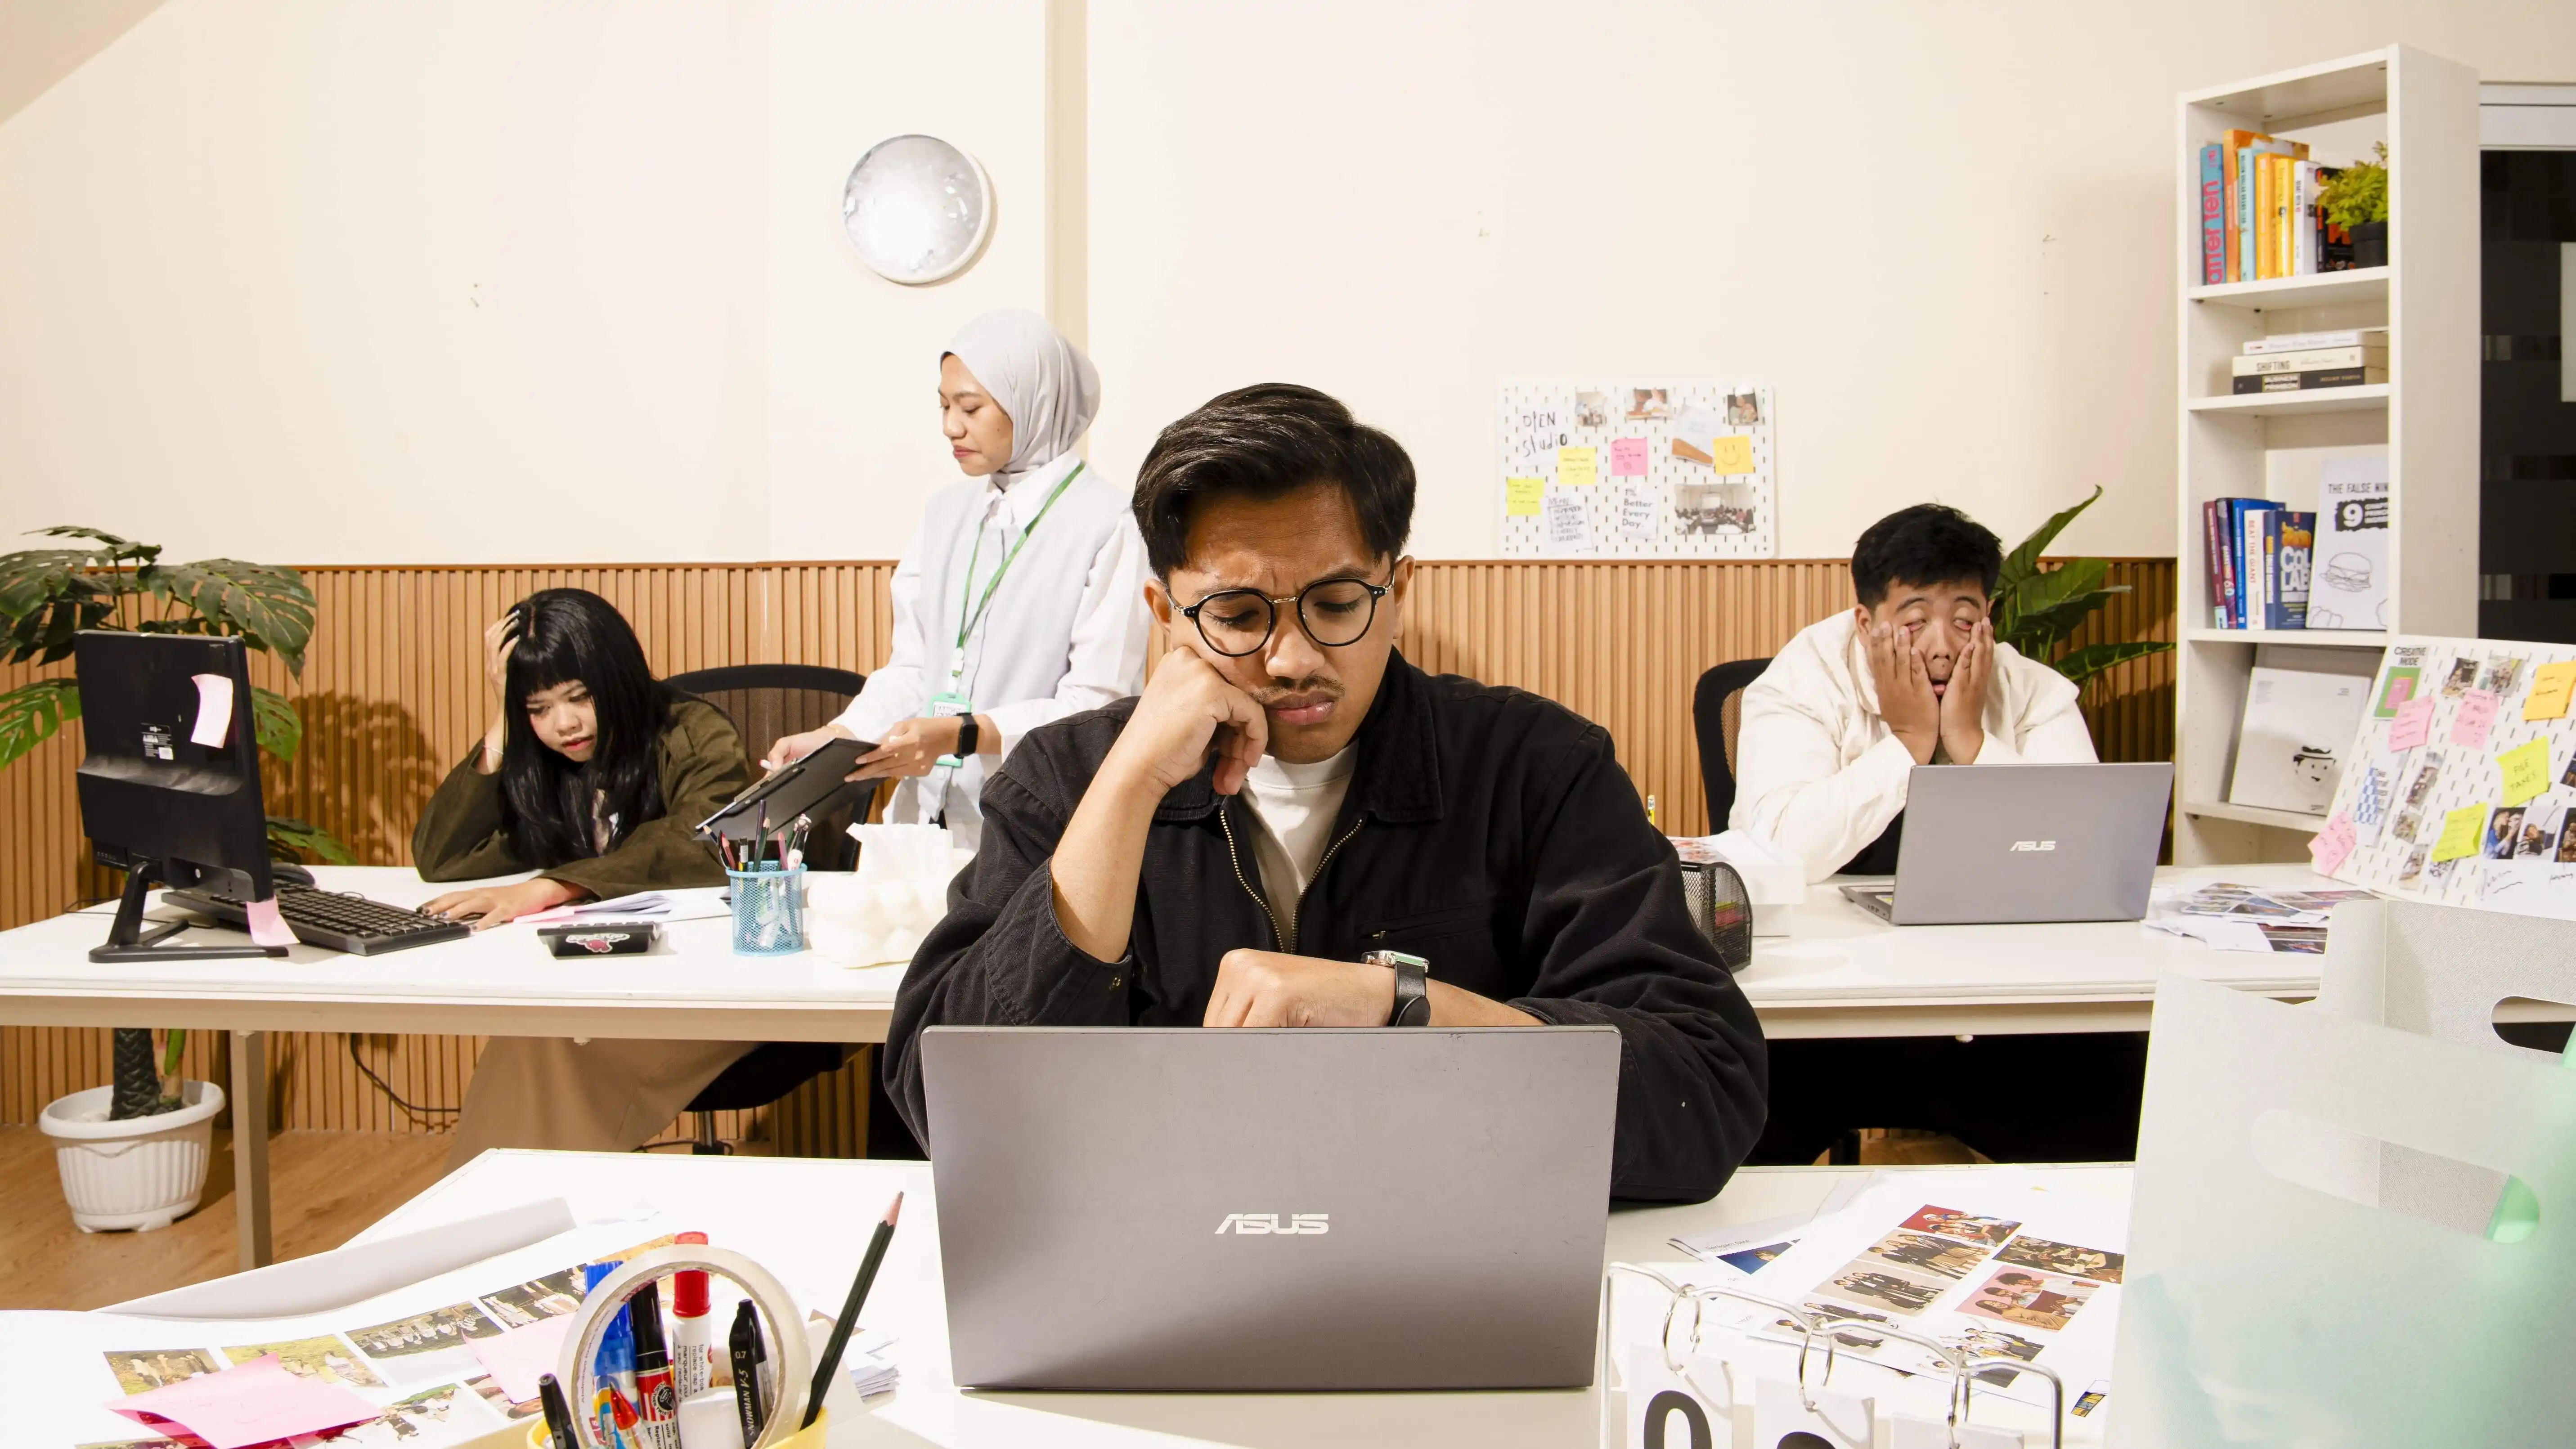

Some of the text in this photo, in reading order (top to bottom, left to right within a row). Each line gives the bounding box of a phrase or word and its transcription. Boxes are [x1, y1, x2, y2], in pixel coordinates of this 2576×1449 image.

[2328, 484, 2343, 494] THE
[1624, 498, 1653, 507] Better
[1623, 507, 1651, 520] Every
[2343, 503, 2364, 527] 9
[2010, 840, 2056, 851] ASUS
[1214, 1213, 1329, 1234] ASUS
[735, 1350, 746, 1359] 0.7
[742, 1390, 756, 1436] SNOWMAN
